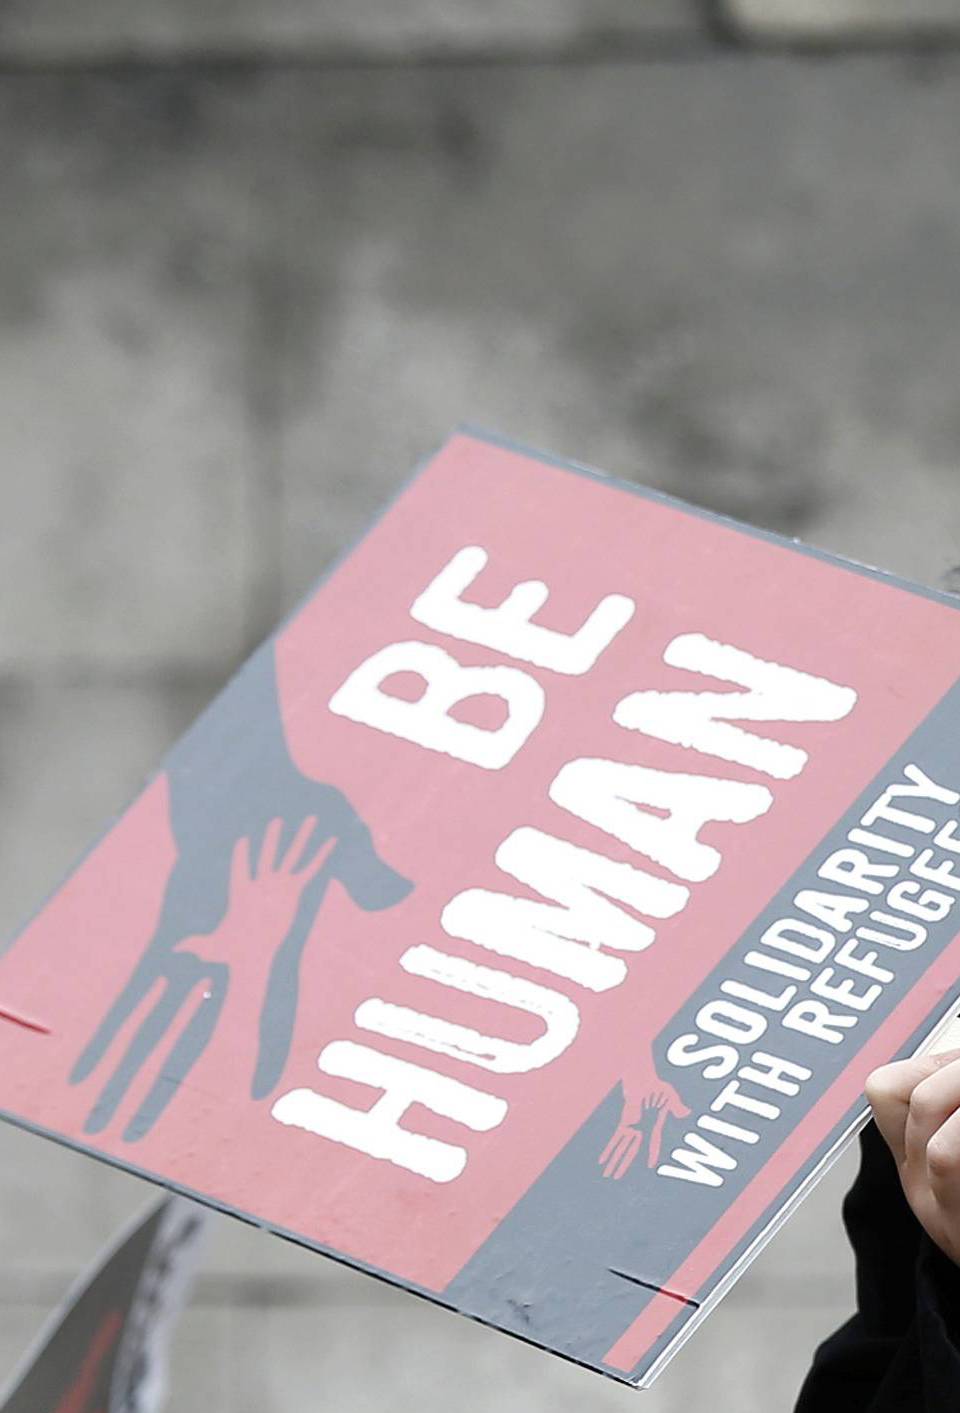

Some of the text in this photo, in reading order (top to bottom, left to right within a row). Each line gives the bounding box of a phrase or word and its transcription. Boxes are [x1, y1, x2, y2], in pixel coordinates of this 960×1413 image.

[329, 545, 635, 770] BE
[270, 631, 857, 1184] HUMAN
[668, 762, 960, 1082] SOLIDARITY
[656, 1050, 813, 1188] WITH
